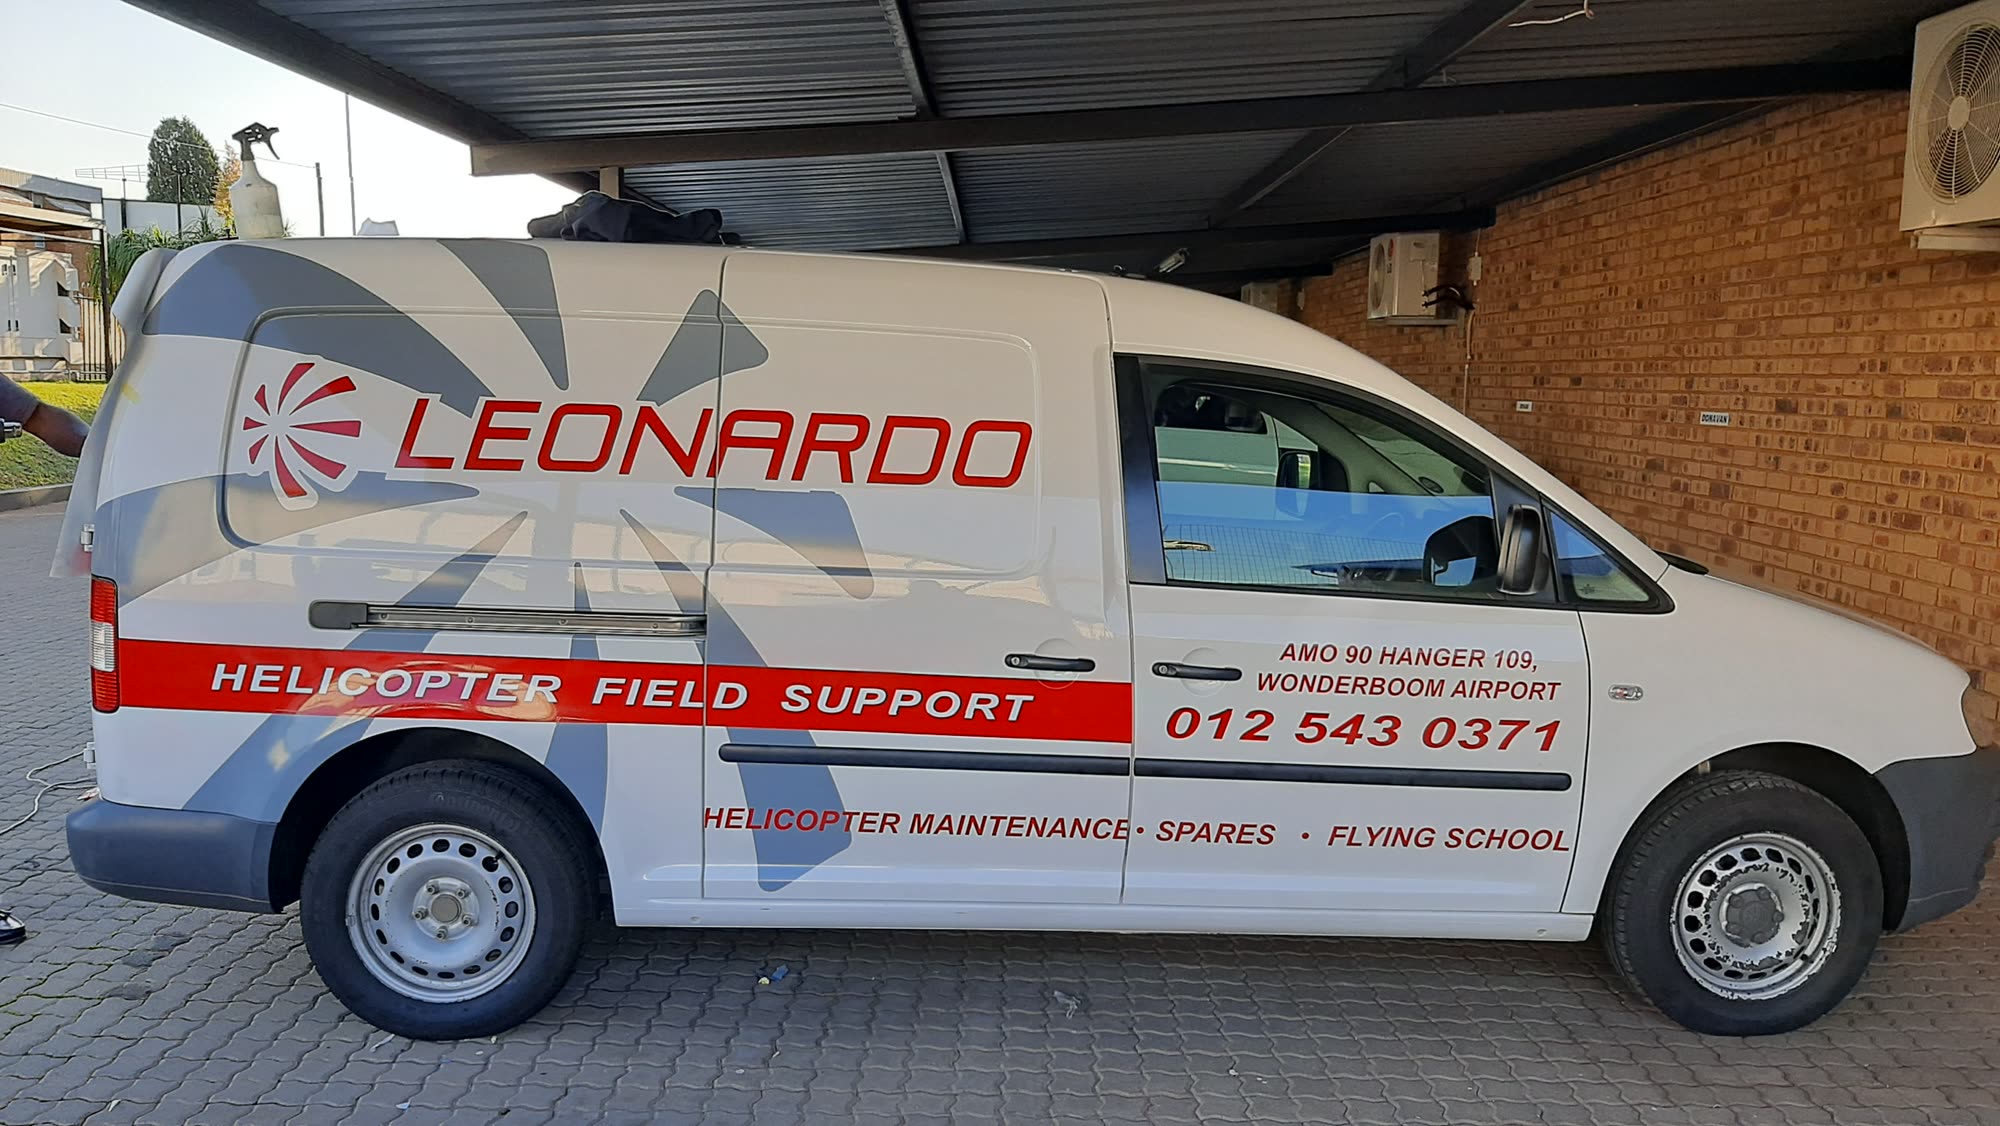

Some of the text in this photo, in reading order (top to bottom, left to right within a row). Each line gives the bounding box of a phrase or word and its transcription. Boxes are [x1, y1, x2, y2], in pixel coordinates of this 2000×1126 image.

[393, 397, 1033, 488] LEONARDO
[1280, 644, 1538, 672] AMO 90 HANGER 109,
[210, 663, 1034, 722] HELICOPTER FIELD SUPPORT
[1257, 673, 1561, 701] WONDERBOOM AIRPORT
[1166, 707, 1561, 752] 012 543 0371
[704, 807, 1570, 852] HELICOPTER MAINTENANCE SPARES FLYING SCHOOL
